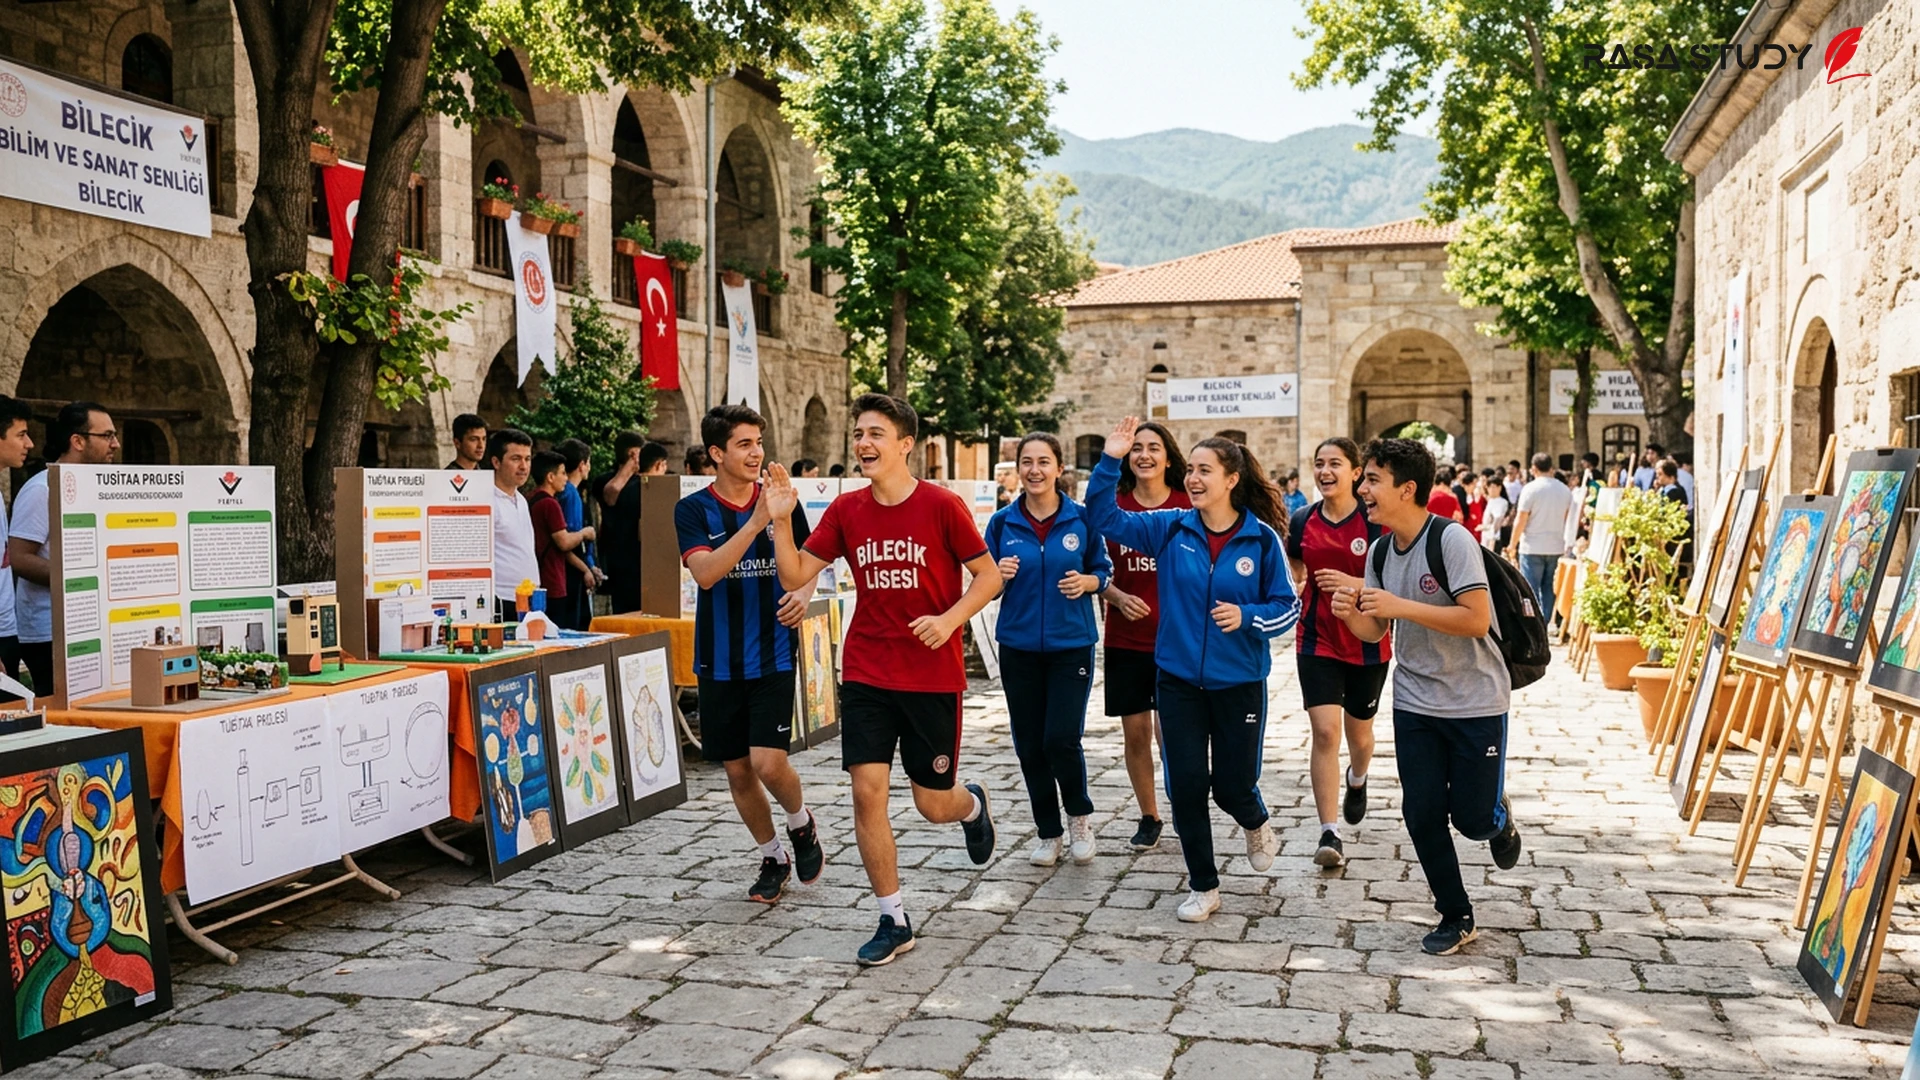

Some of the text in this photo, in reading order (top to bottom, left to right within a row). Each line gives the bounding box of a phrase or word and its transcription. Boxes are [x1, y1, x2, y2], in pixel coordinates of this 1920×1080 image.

[61, 100, 154, 151] BİLECİK
[0, 126, 49, 159] BİLİM
[54, 142, 78, 166] VE
[83, 150, 138, 180] SANAT
[78, 180, 145, 215] BİLECİK
[856, 536, 927, 568] BİLECİK
